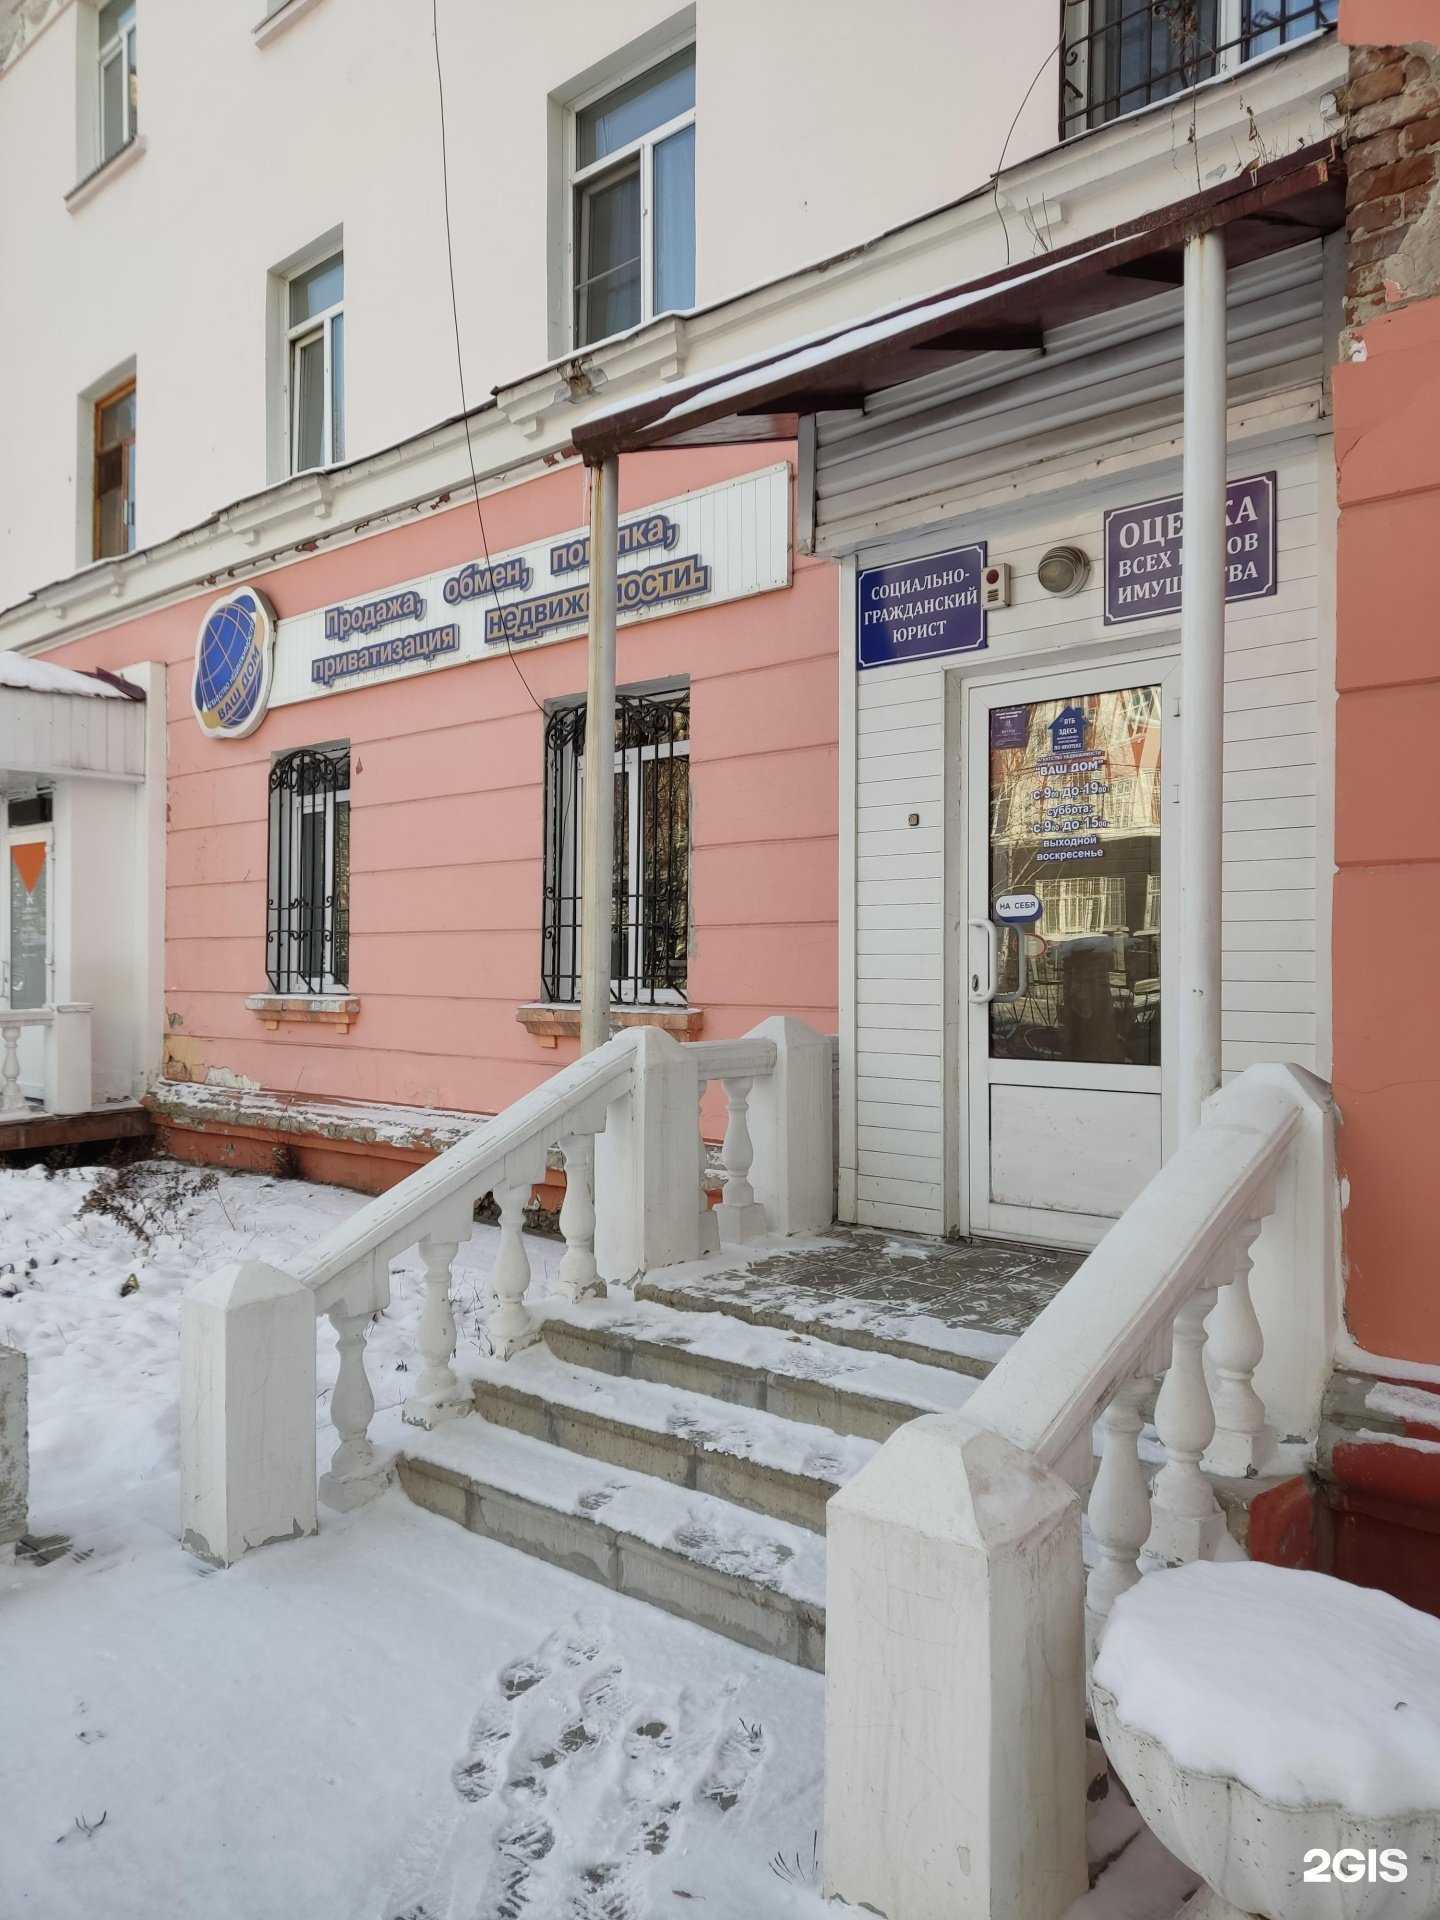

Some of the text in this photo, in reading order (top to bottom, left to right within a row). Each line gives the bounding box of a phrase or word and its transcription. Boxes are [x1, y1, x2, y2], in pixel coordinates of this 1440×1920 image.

[1119, 495, 1258, 548] ОЦЕА
[1118, 551, 1172, 578] ВСЕХ
[326, 517, 677, 640] Продажа, обмен, попка,
[871, 568, 970, 600] СОЦИАЛЬНО-
[1118, 561, 1258, 604] ИМУЩВА
[864, 586, 978, 625] ГРАЖДАНСКИЙ
[313, 625, 456, 685] приватизация
[487, 557, 707, 639] недвижости.
[893, 620, 946, 643] ЮРИСТ
[218, 688, 242, 720] ВАШ
[241, 645, 260, 689] ДОМ
[1058, 728, 1078, 736] ЗДЕСЬ
[1062, 787, 1080, 799] до
[1062, 820, 1080, 832] до
[1043, 834, 1097, 848] выходной
[1036, 849, 1104, 861] воскресенье
[1000, 901, 1036, 910] НА СЕБЯ
